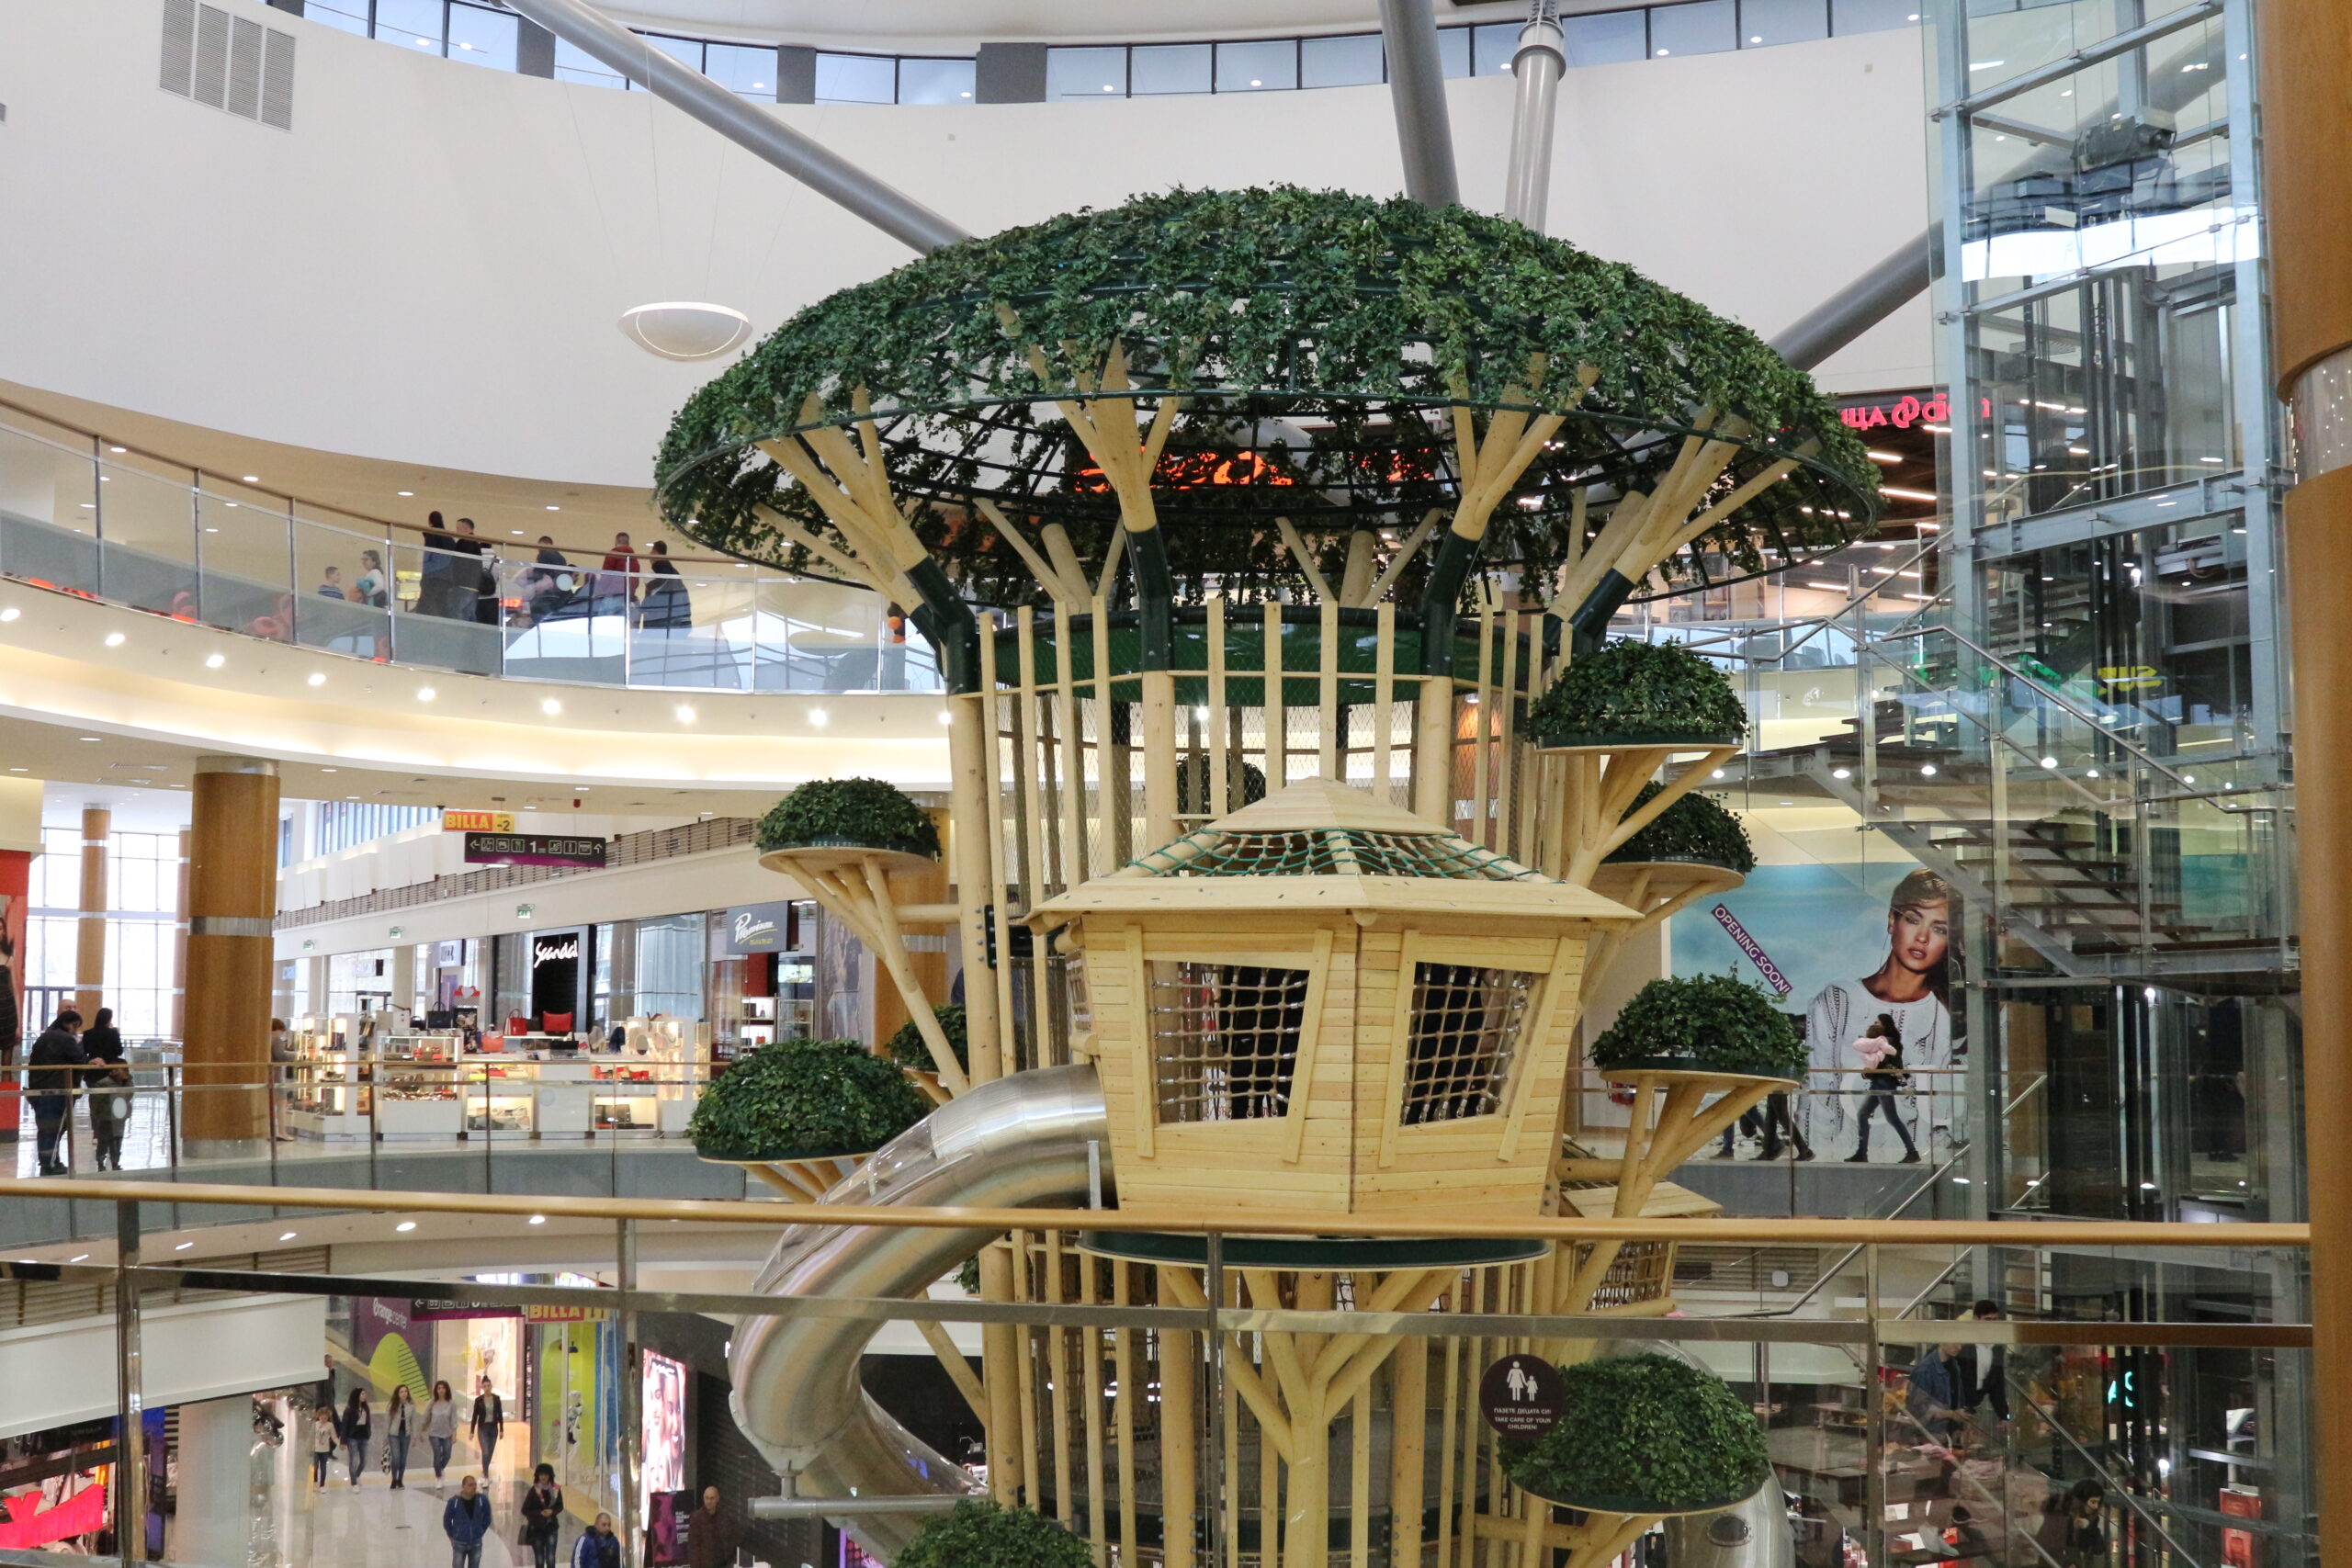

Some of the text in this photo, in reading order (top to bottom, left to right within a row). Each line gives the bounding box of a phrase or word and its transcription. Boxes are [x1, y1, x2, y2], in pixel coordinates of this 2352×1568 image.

[445, 814, 510, 832] BILLA -2
[534, 940, 579, 968] Scandal
[1714, 907, 1791, 993] OPENING SOON!
[530, 1304, 581, 1320] BILLA
